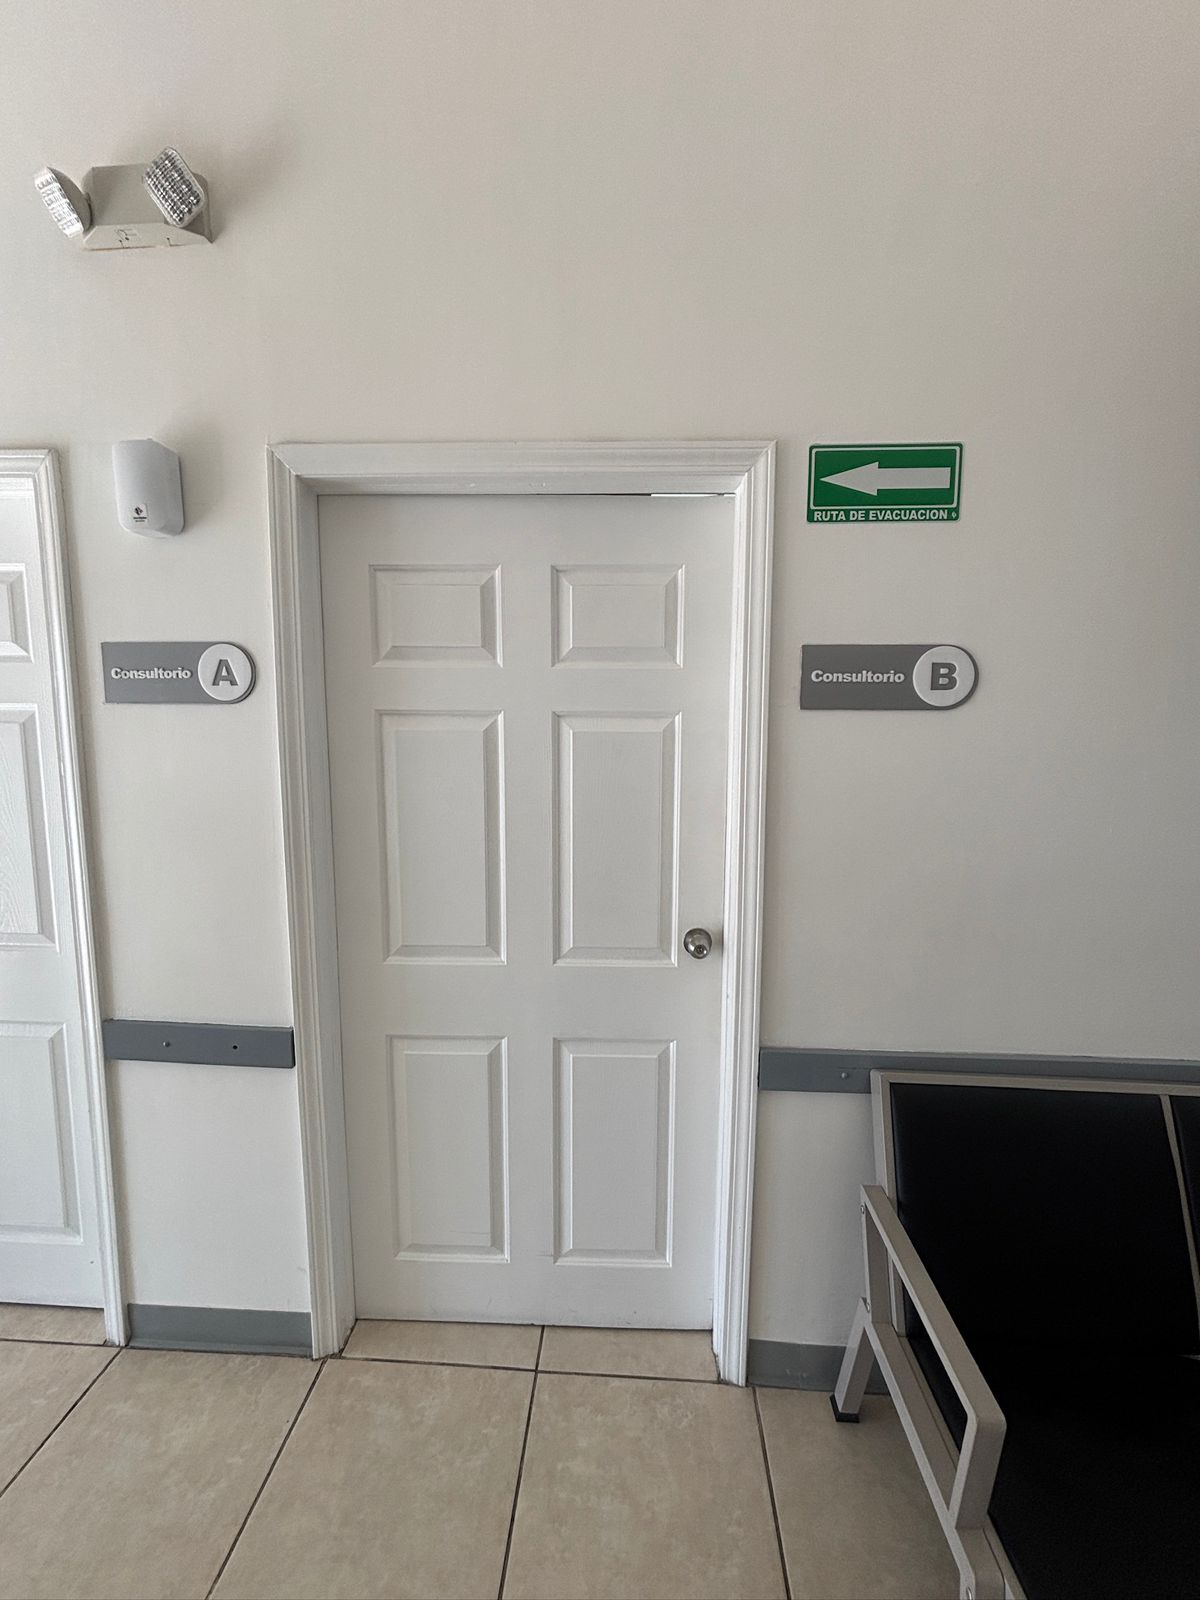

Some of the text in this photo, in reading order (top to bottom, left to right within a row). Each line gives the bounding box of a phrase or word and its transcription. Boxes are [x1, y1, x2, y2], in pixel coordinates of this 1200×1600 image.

[813, 509, 948, 521] RUTA DE EVACUACION
[110, 658, 239, 686] Consultorio A
[810, 661, 958, 691] Consultorio B
